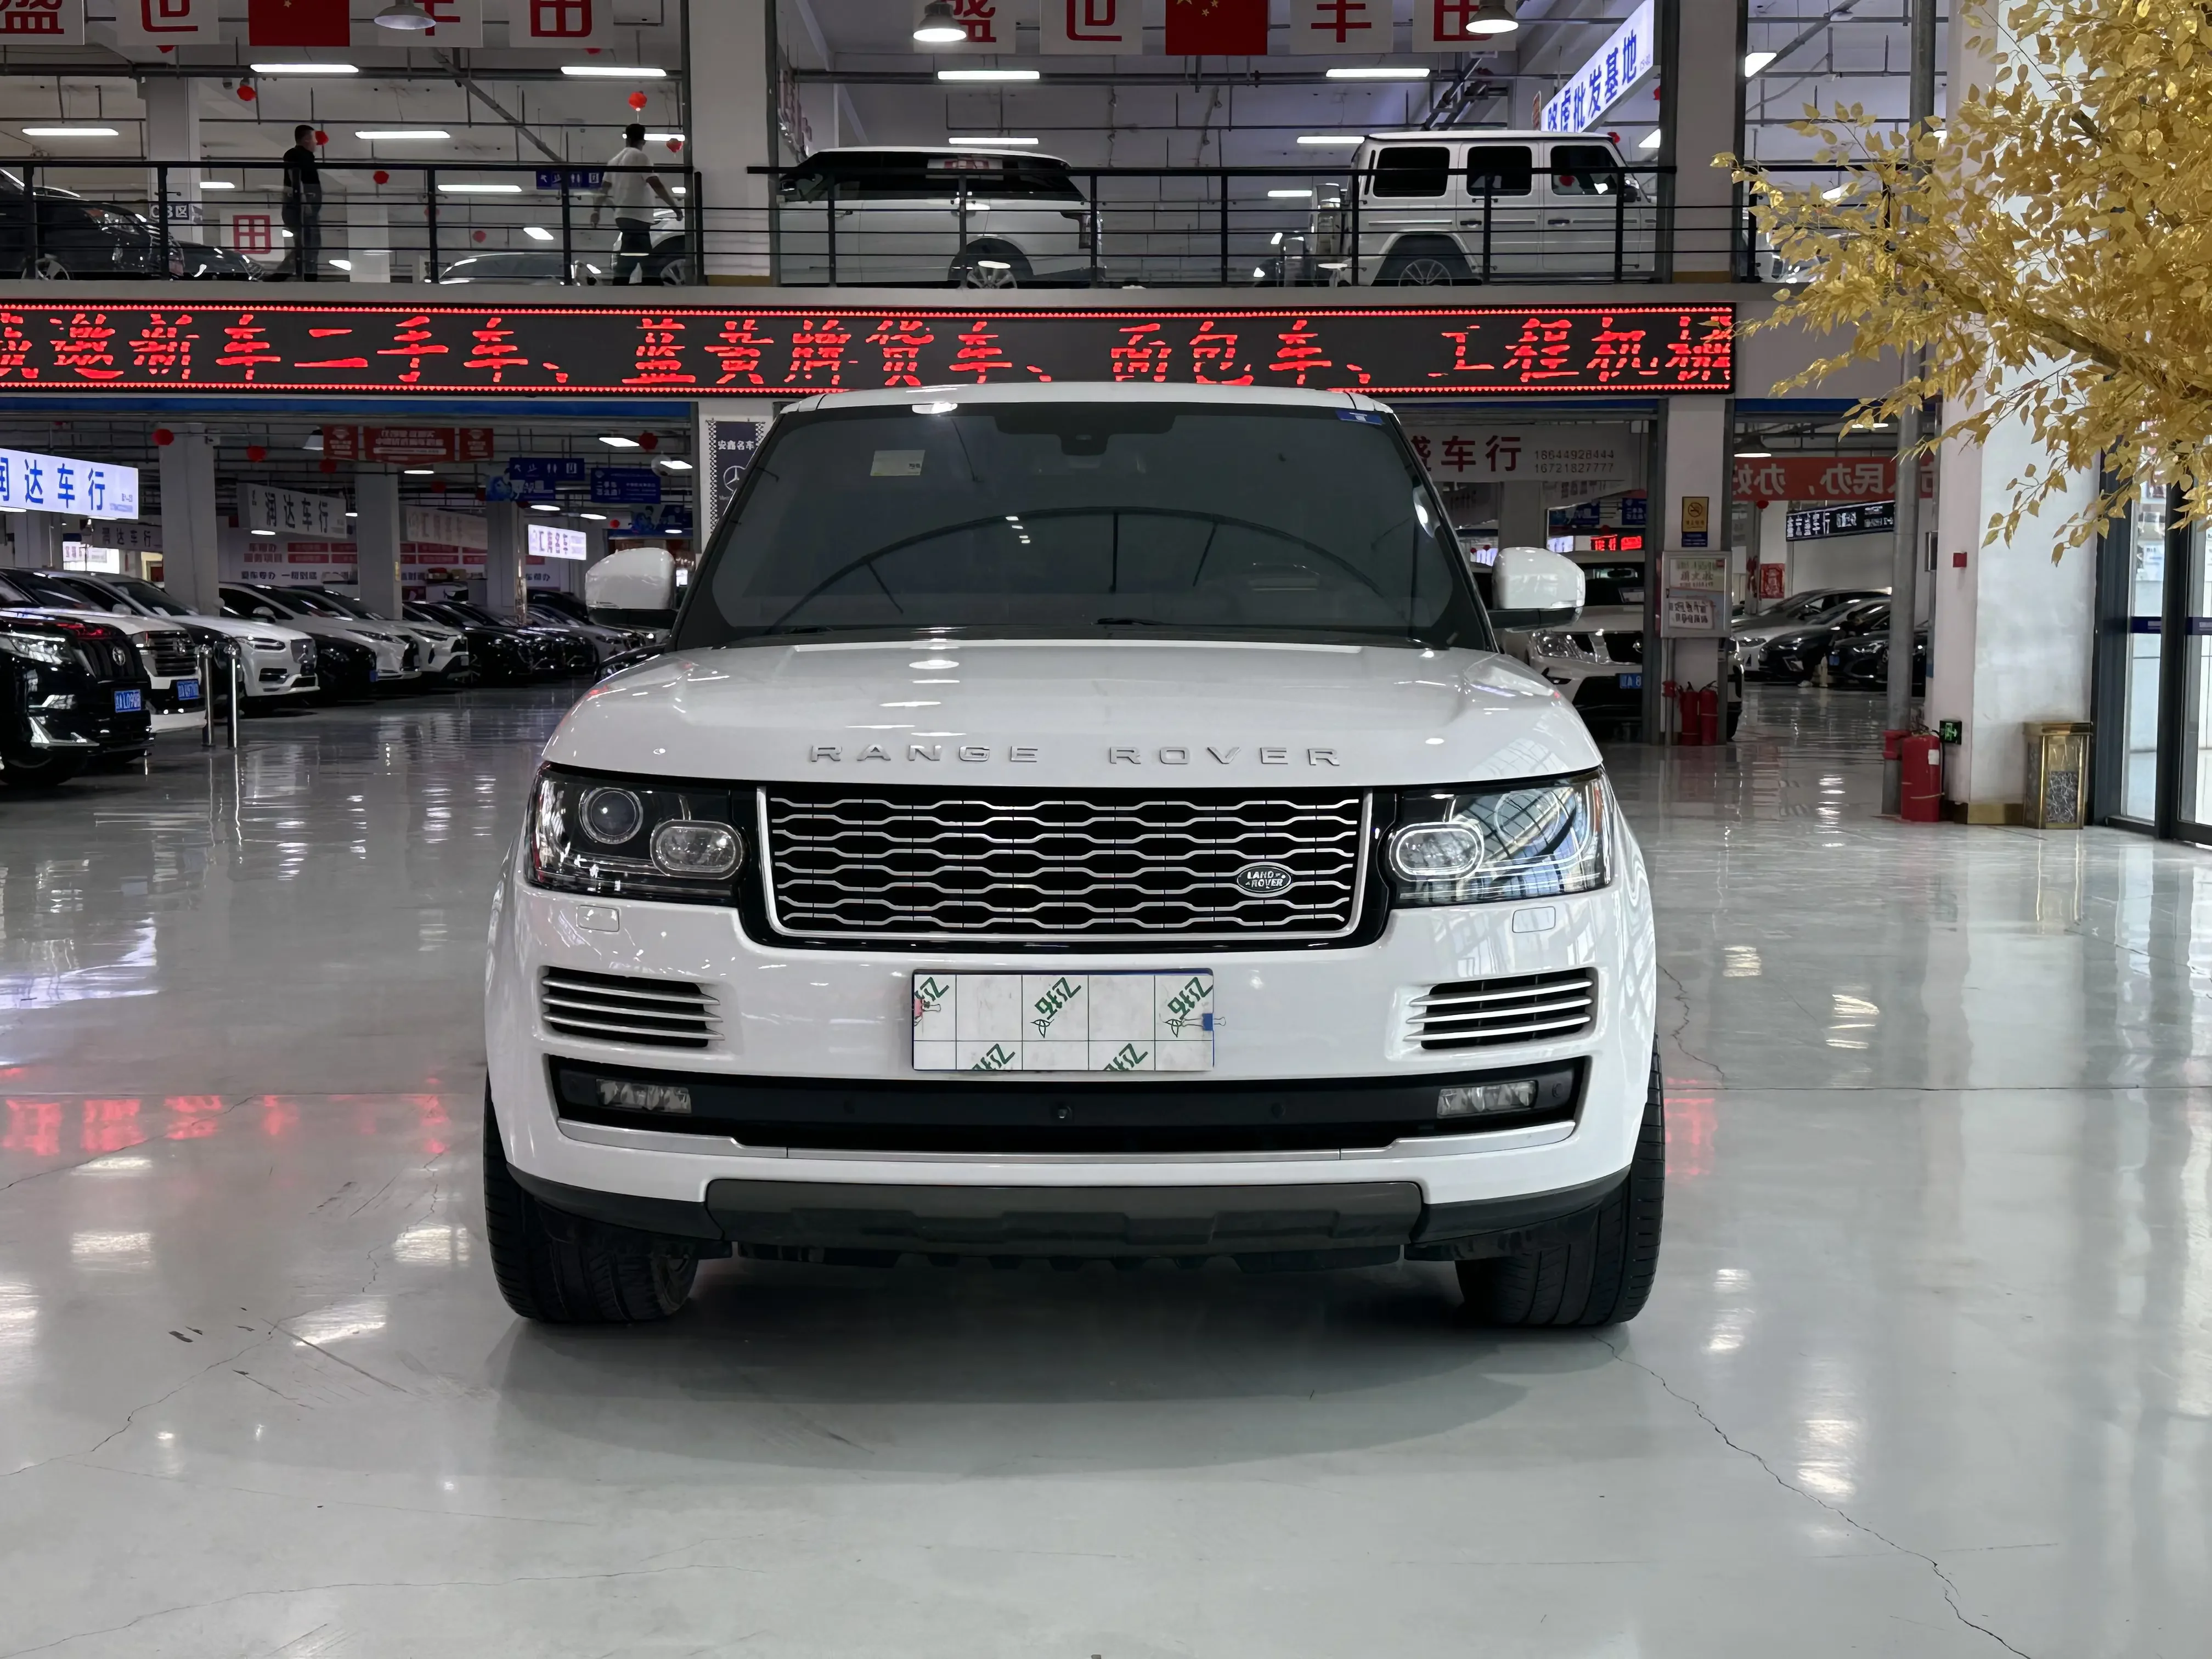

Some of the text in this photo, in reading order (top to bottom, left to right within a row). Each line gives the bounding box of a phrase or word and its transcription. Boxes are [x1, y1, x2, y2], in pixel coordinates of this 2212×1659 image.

[1534, 463, 1614, 473] 16721827777
[810, 743, 1340, 766] RANGE ROVER
[1251, 878, 1283, 888] ROVER
